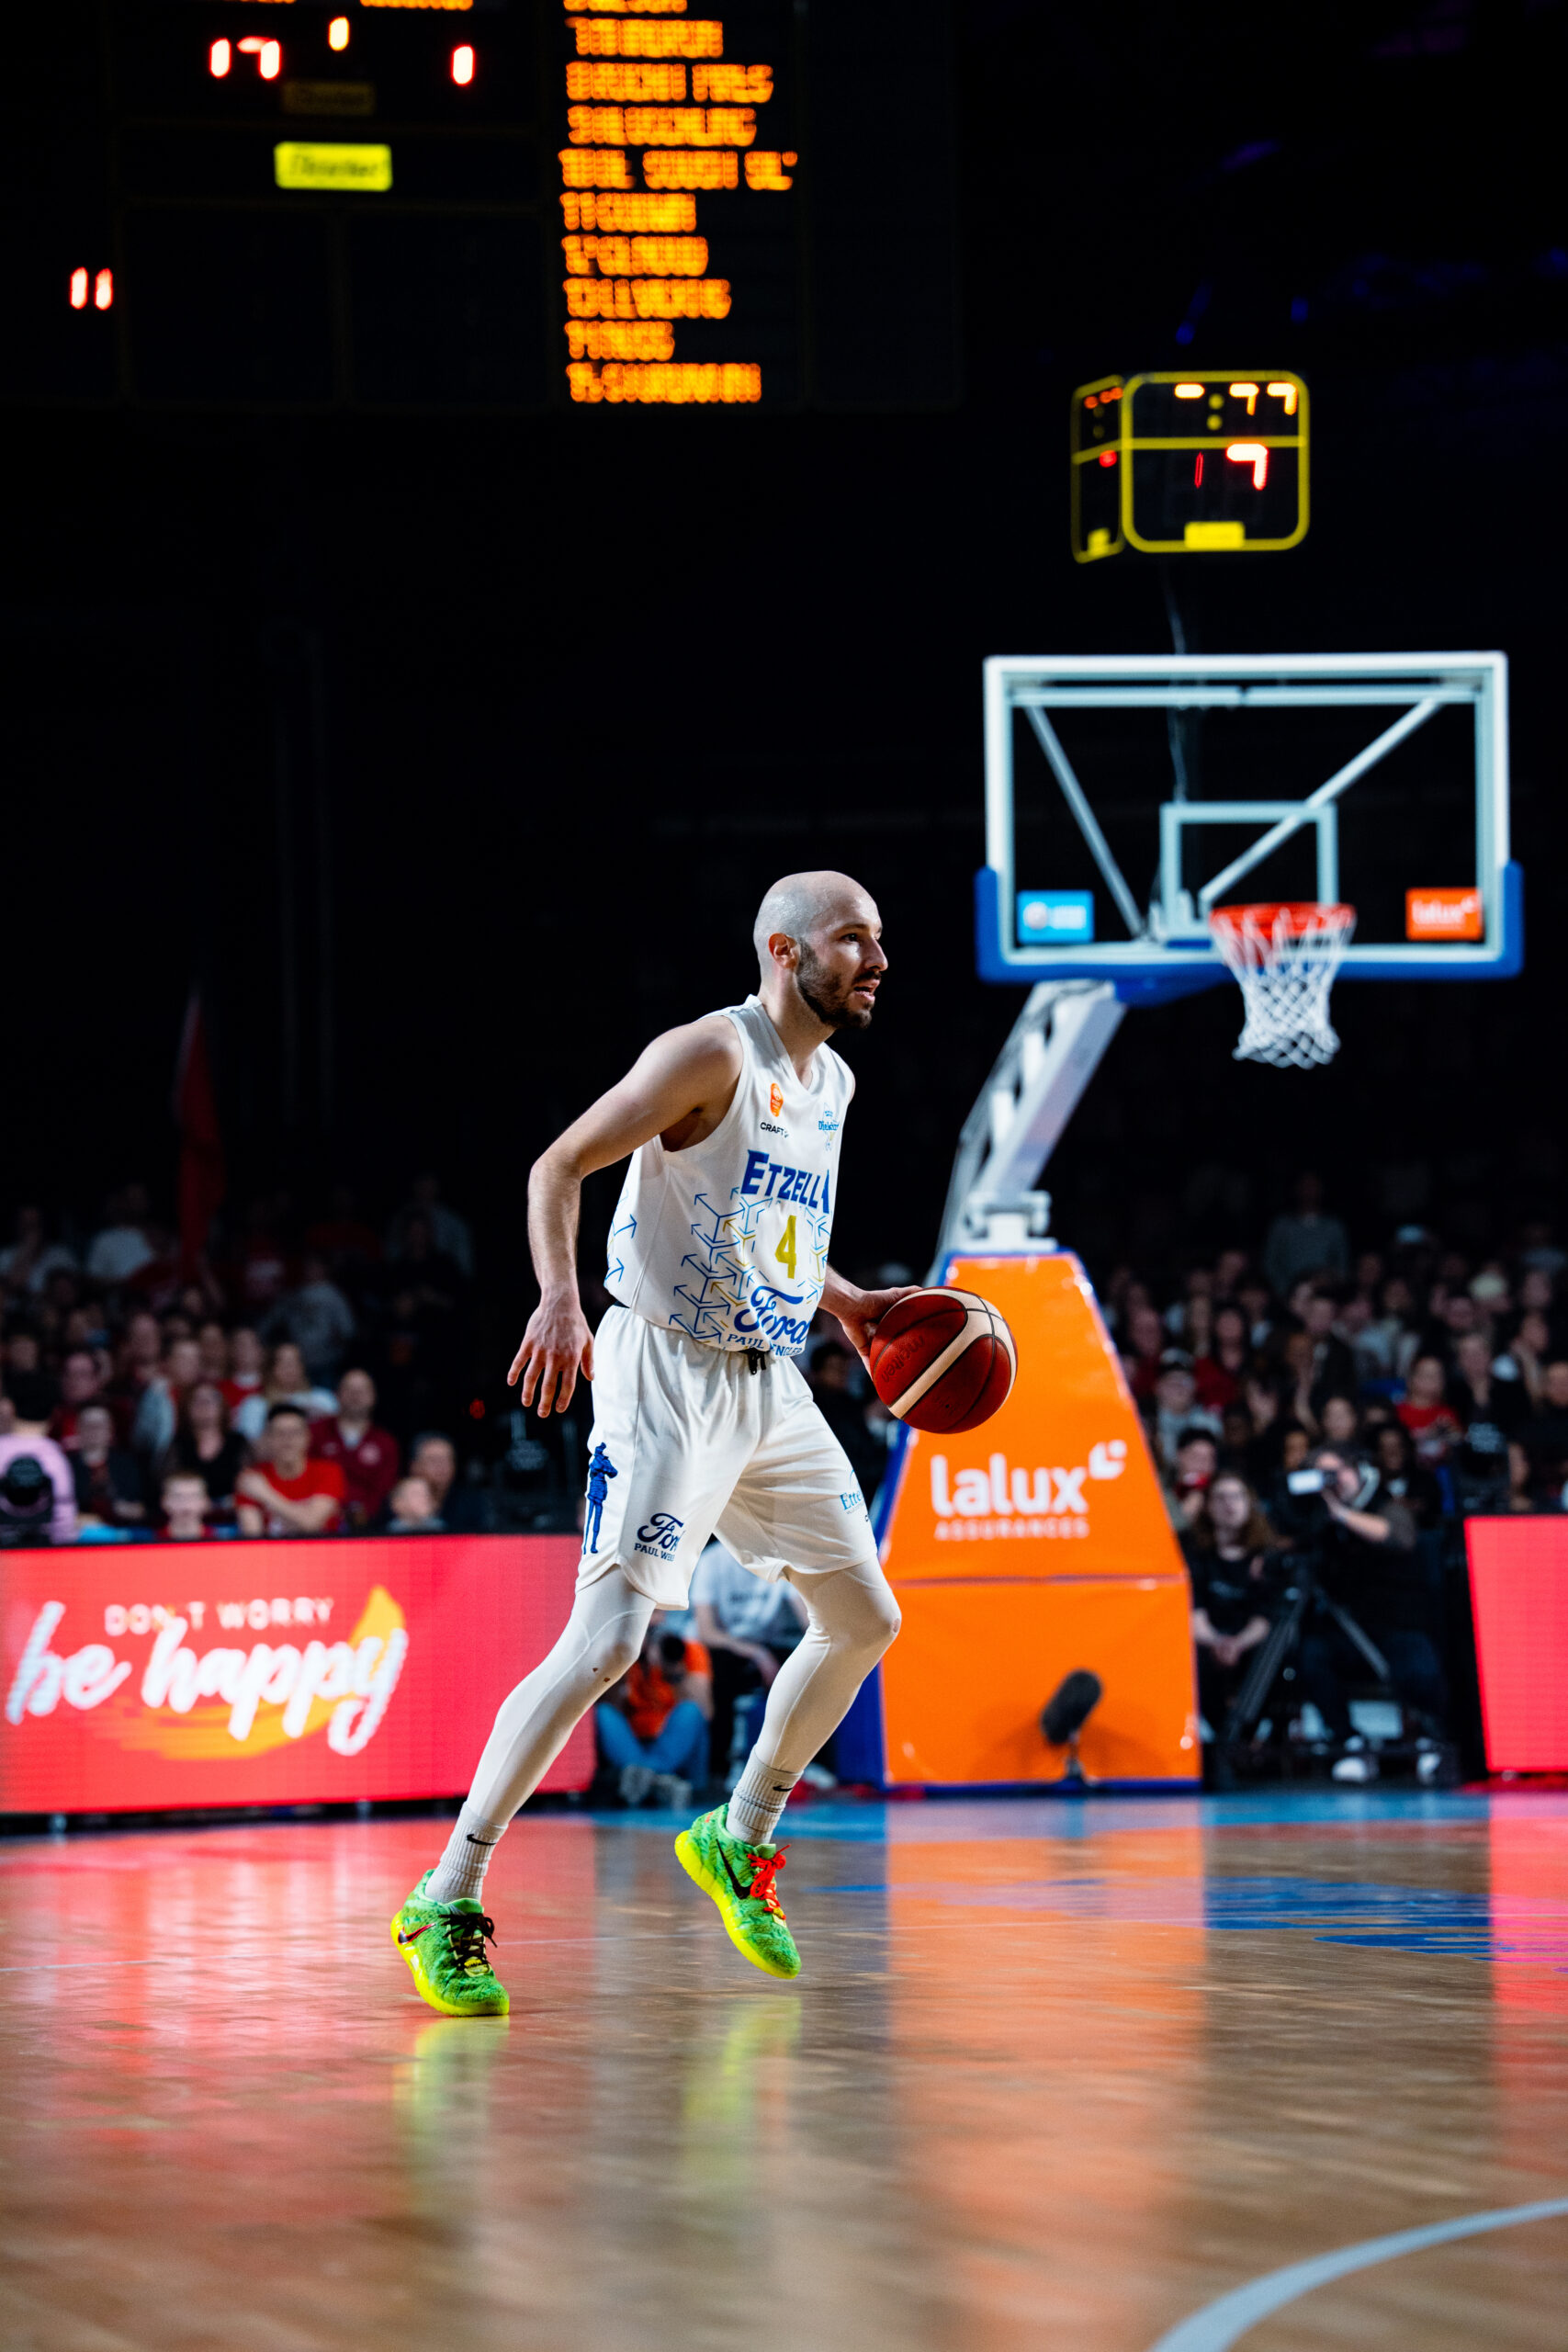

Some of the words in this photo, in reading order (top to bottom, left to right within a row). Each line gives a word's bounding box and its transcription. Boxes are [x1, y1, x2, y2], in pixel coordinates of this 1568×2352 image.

[760, 1122, 784, 1136] CRAFT
[740, 1148, 830, 1215] ETZELLA
[774, 1215, 797, 1279] 4
[733, 1285, 809, 1344] Ford
[727, 1333, 765, 1349] PAUL
[931, 1453, 1089, 1517] lalux
[633, 1543, 659, 1557] PAUL
[637, 1512, 685, 1552] For
[104, 1601, 206, 1636] DONT
[216, 1597, 334, 1630] WORRY
[6, 1601, 131, 1725] be
[141, 1617, 409, 1756] happy
